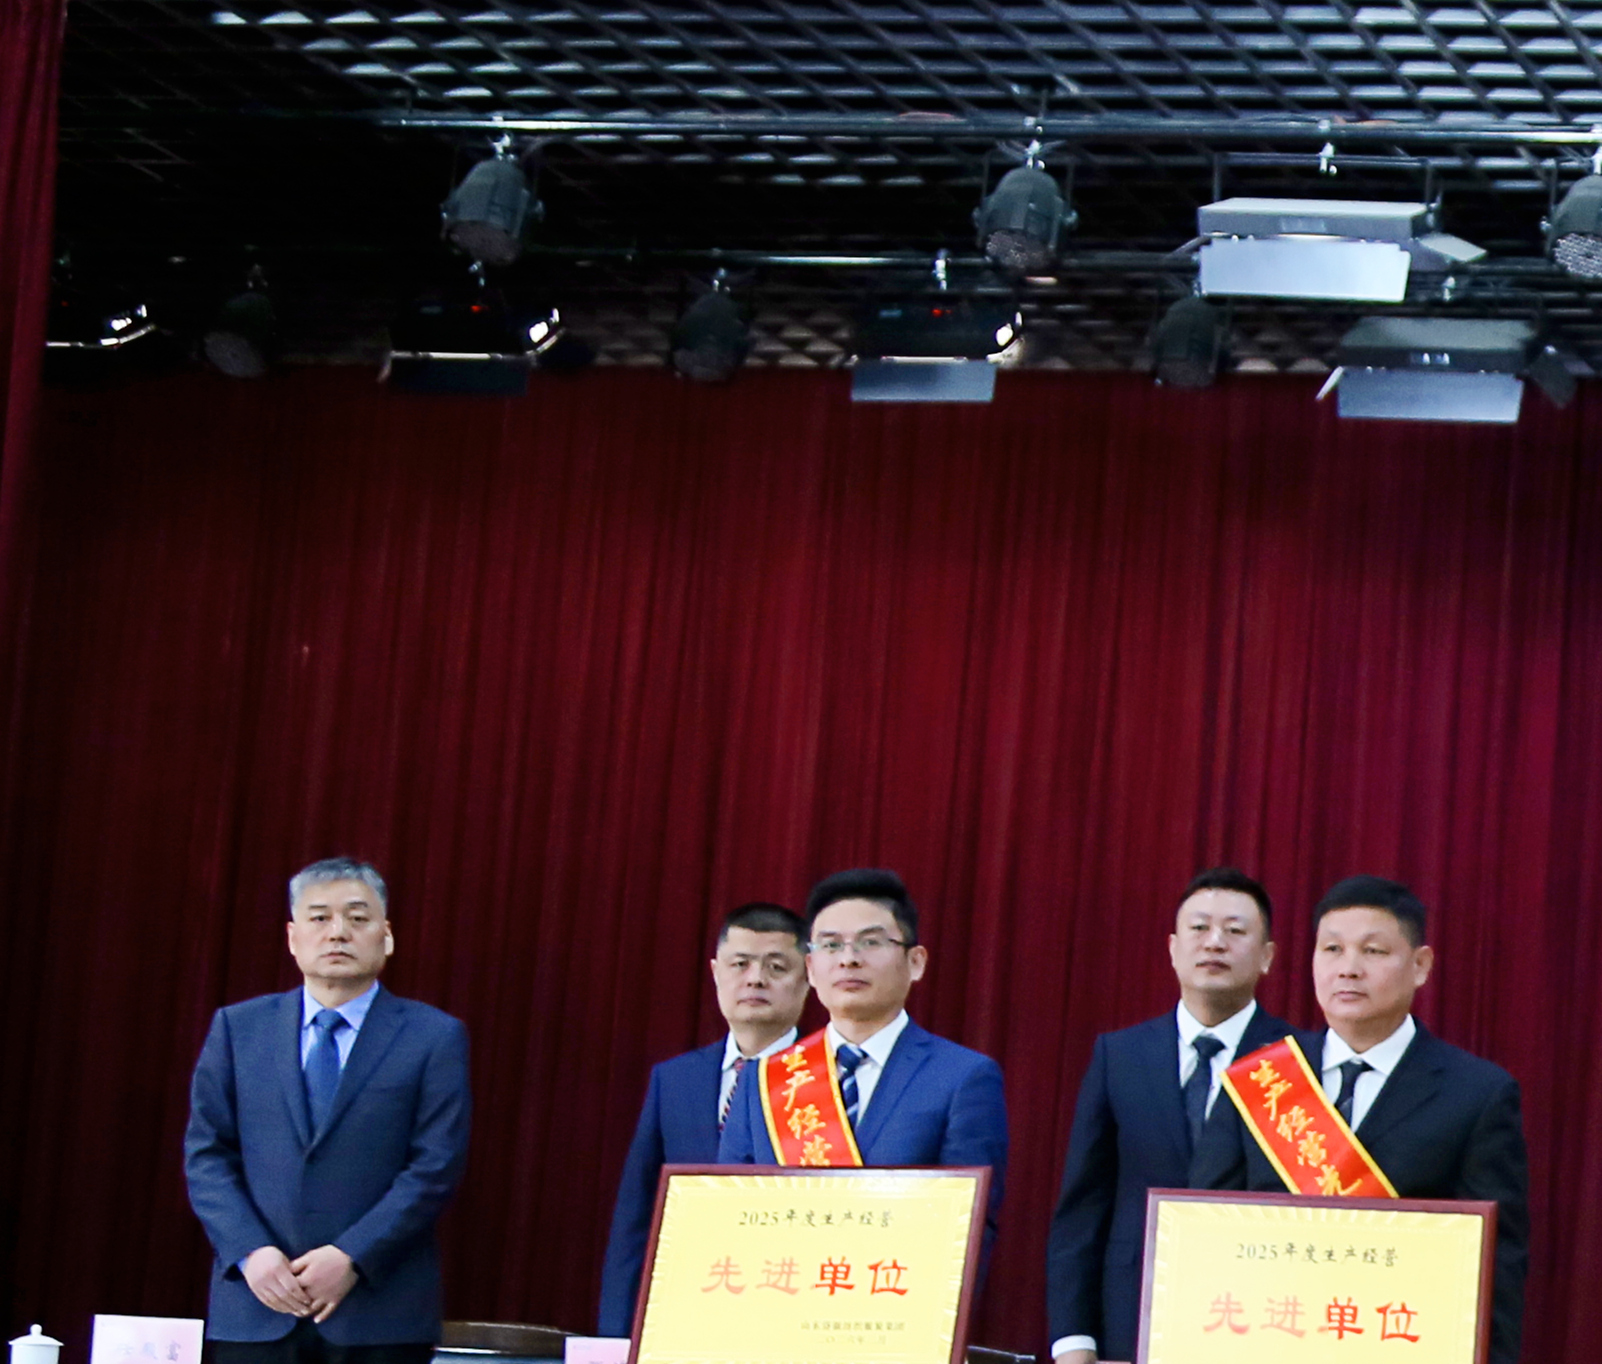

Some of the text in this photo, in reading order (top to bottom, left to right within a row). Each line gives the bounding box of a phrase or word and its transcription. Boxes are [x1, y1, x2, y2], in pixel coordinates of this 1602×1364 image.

[781, 1044, 832, 1166] 生产经营
[1249, 1059, 1363, 1196] 生产经营先
[738, 1208, 895, 1228] 2025年度生产经营
[701, 1255, 910, 1297] 先进单位
[1236, 1242, 1399, 1268] 2025年度生产经营
[1203, 1292, 1421, 1344] 先进单位
